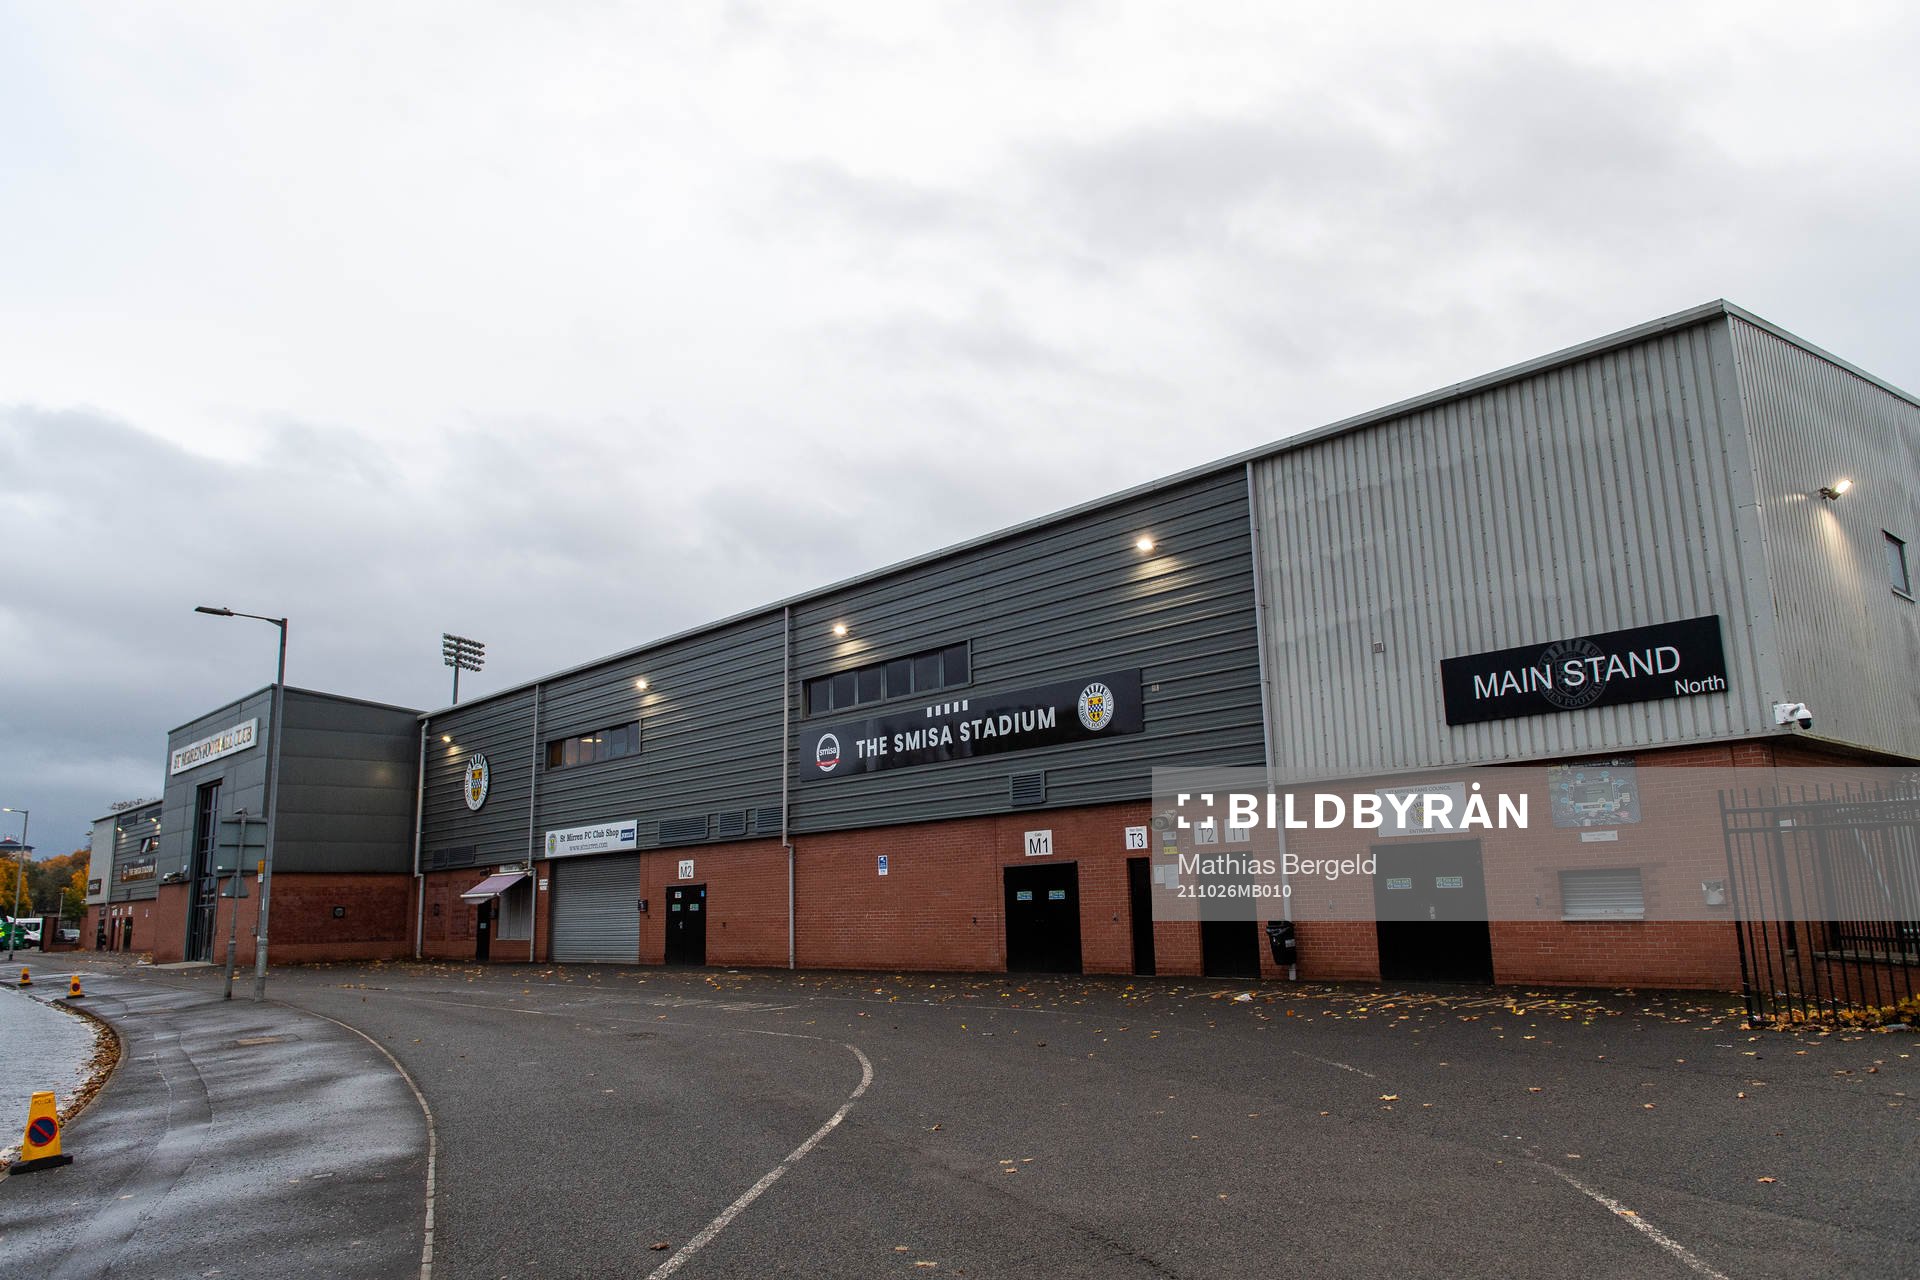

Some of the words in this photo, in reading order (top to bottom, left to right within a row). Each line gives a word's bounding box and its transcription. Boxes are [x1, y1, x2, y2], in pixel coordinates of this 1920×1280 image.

[1474, 663, 1553, 700] MAIN
[1563, 646, 1681, 687] STAND
[1674, 675, 1726, 696] North
[856, 736, 888, 759] THE
[894, 725, 953, 753] SMISA
[959, 706, 1057, 742] STADIUM
[819, 746, 837, 756] smisa
[560, 834, 566, 842] St
[566, 832, 583, 842] Mirren
[592, 829, 604, 839] Club
[605, 828, 619, 839] Shop
[1129, 832, 1144, 848] T3
[1198, 828, 1214, 843] T2
[1029, 837, 1048, 855] M1
[680, 865, 692, 878] M2
